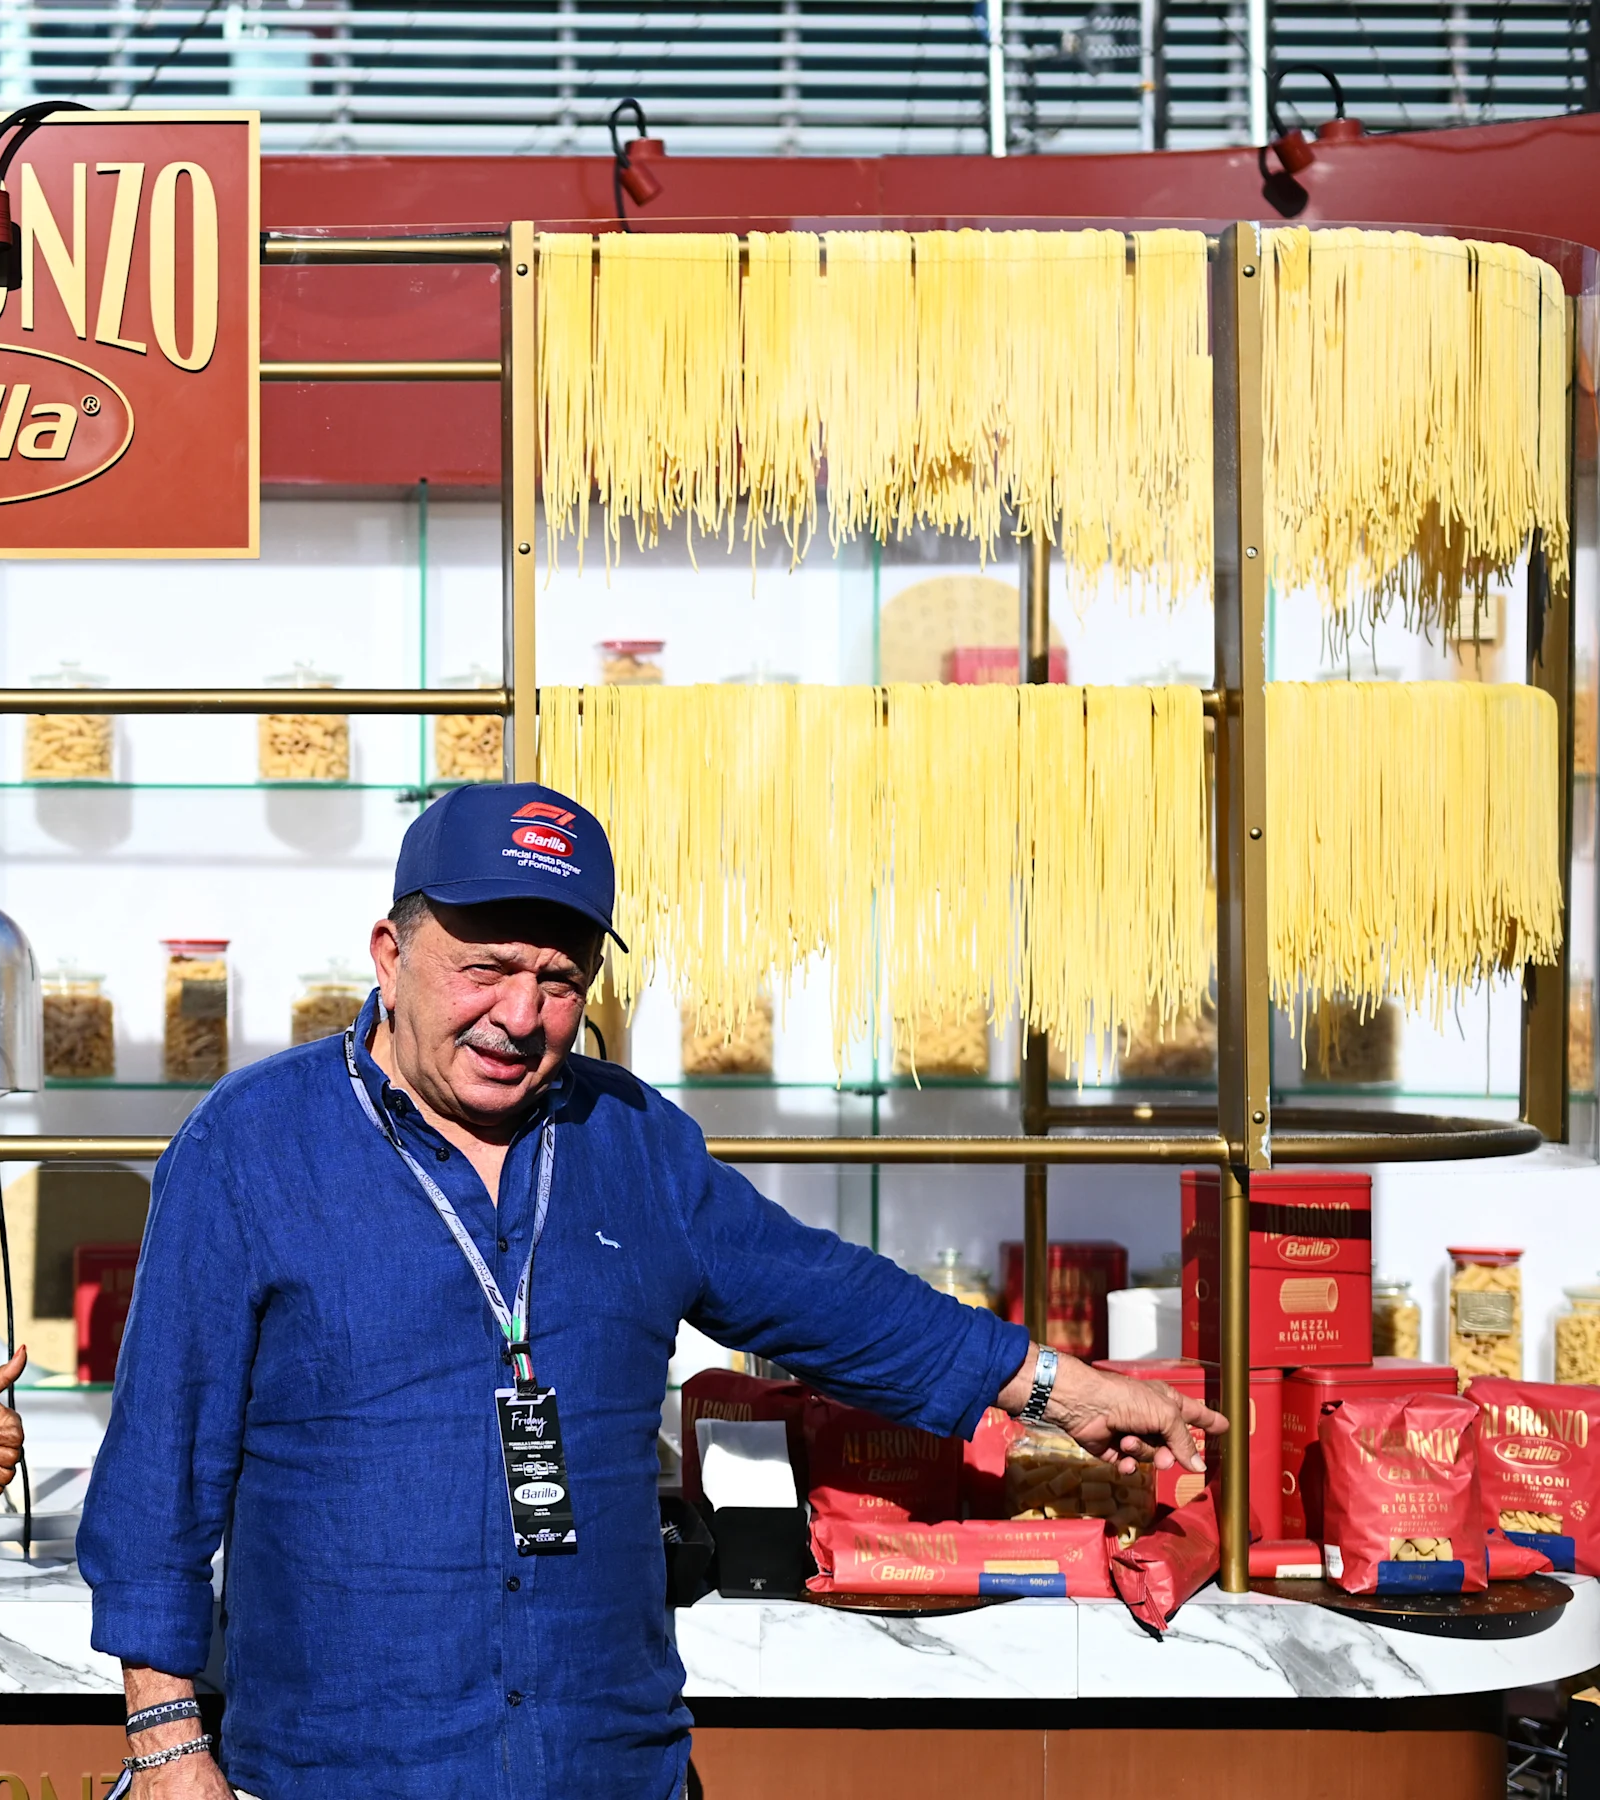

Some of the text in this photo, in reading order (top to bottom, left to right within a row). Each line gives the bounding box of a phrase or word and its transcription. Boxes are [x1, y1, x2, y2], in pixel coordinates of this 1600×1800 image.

[523, 831, 566, 853] Barilla
[501, 848, 582, 875] Official Pasta Partner
[517, 858, 528, 866] of
[528, 860, 561, 875] Formula
[1285, 1241, 1332, 1257] Barilla
[1290, 1320, 1328, 1331] MEZZI
[1279, 1330, 1339, 1342] RIGATONI
[511, 1404, 548, 1438] Friday
[1480, 1403, 1589, 1448] AL BRONZO
[866, 1428, 940, 1461] BRONZO
[1504, 1443, 1562, 1462] Barilla
[867, 1467, 919, 1482] Barilla
[522, 1488, 558, 1500] Barilla
[1395, 1493, 1441, 1503] MEZZI
[1381, 1503, 1449, 1514] RIGATON
[878, 1533, 959, 1564] BRONZO
[880, 1565, 936, 1581] Barilla
